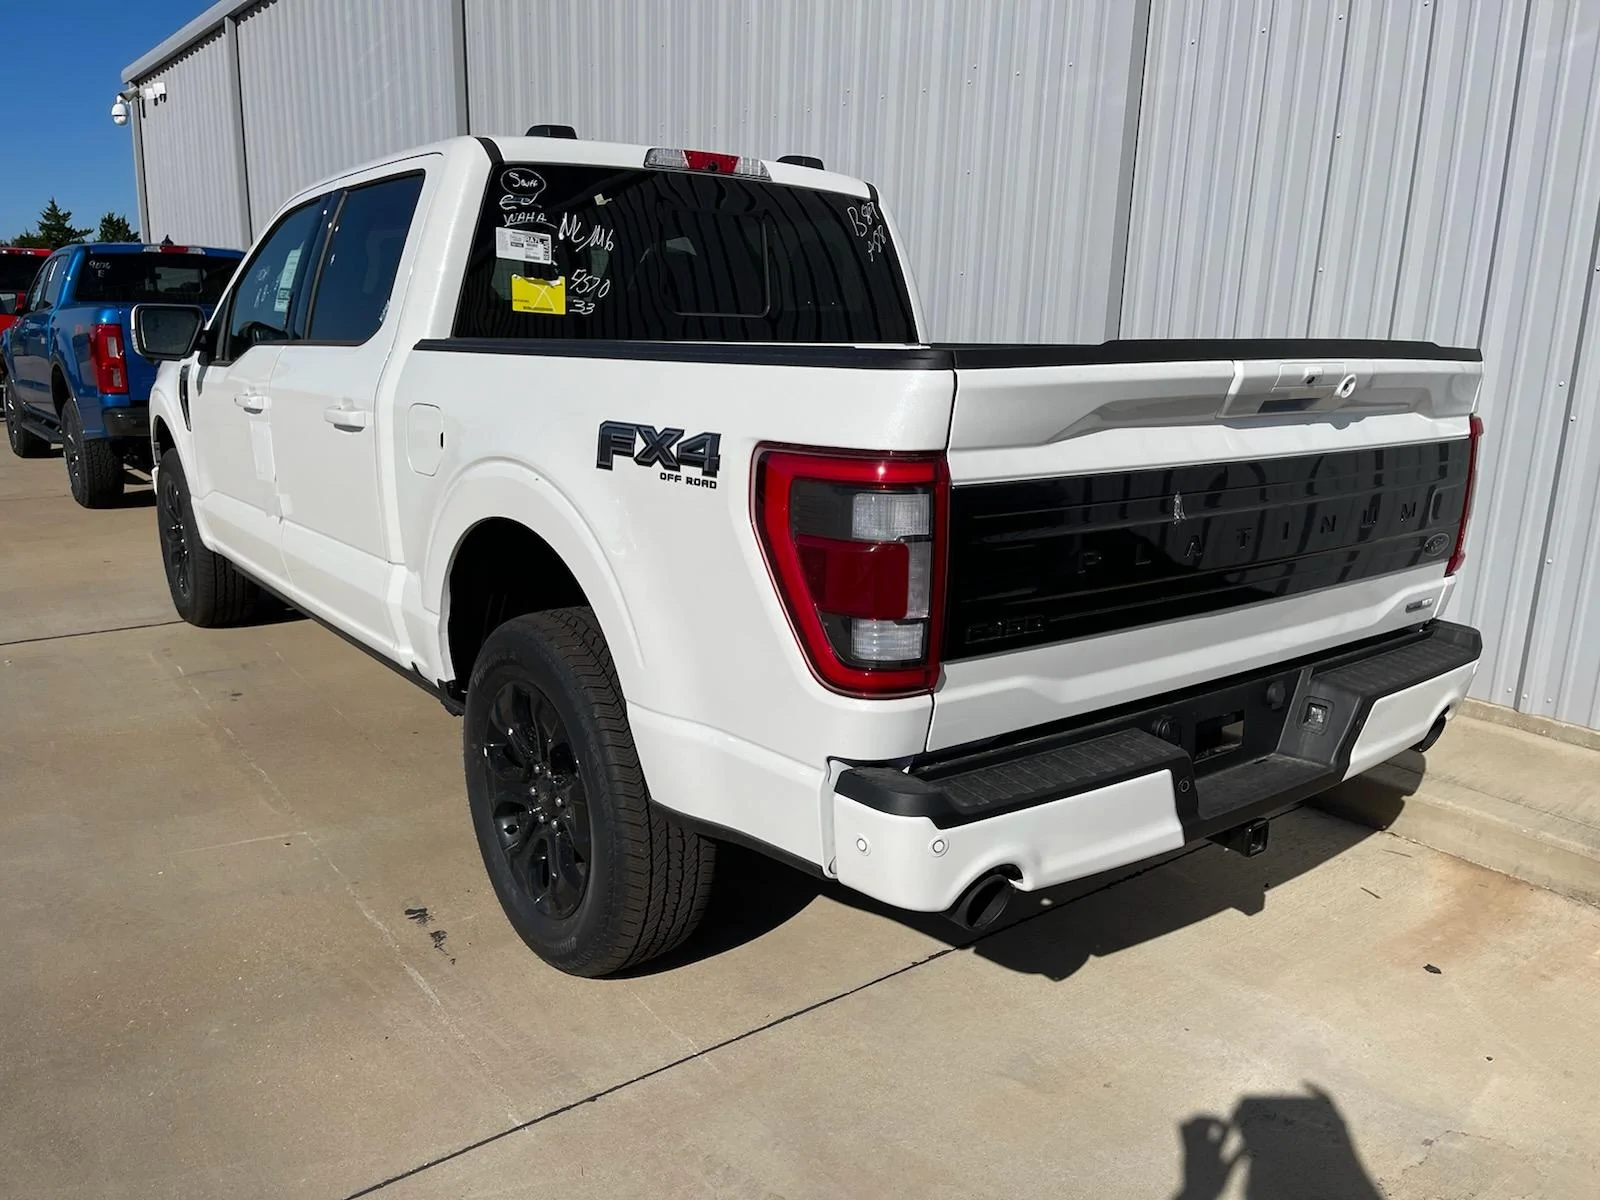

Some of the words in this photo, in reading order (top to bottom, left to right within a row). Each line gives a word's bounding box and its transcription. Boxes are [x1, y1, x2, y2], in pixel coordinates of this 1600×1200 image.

[569, 299, 596, 316] 33
[596, 419, 722, 479] FX4
[659, 472, 682, 483] OFF
[685, 476, 718, 490] ROAD
[1077, 501, 1417, 575] PLATINUM
